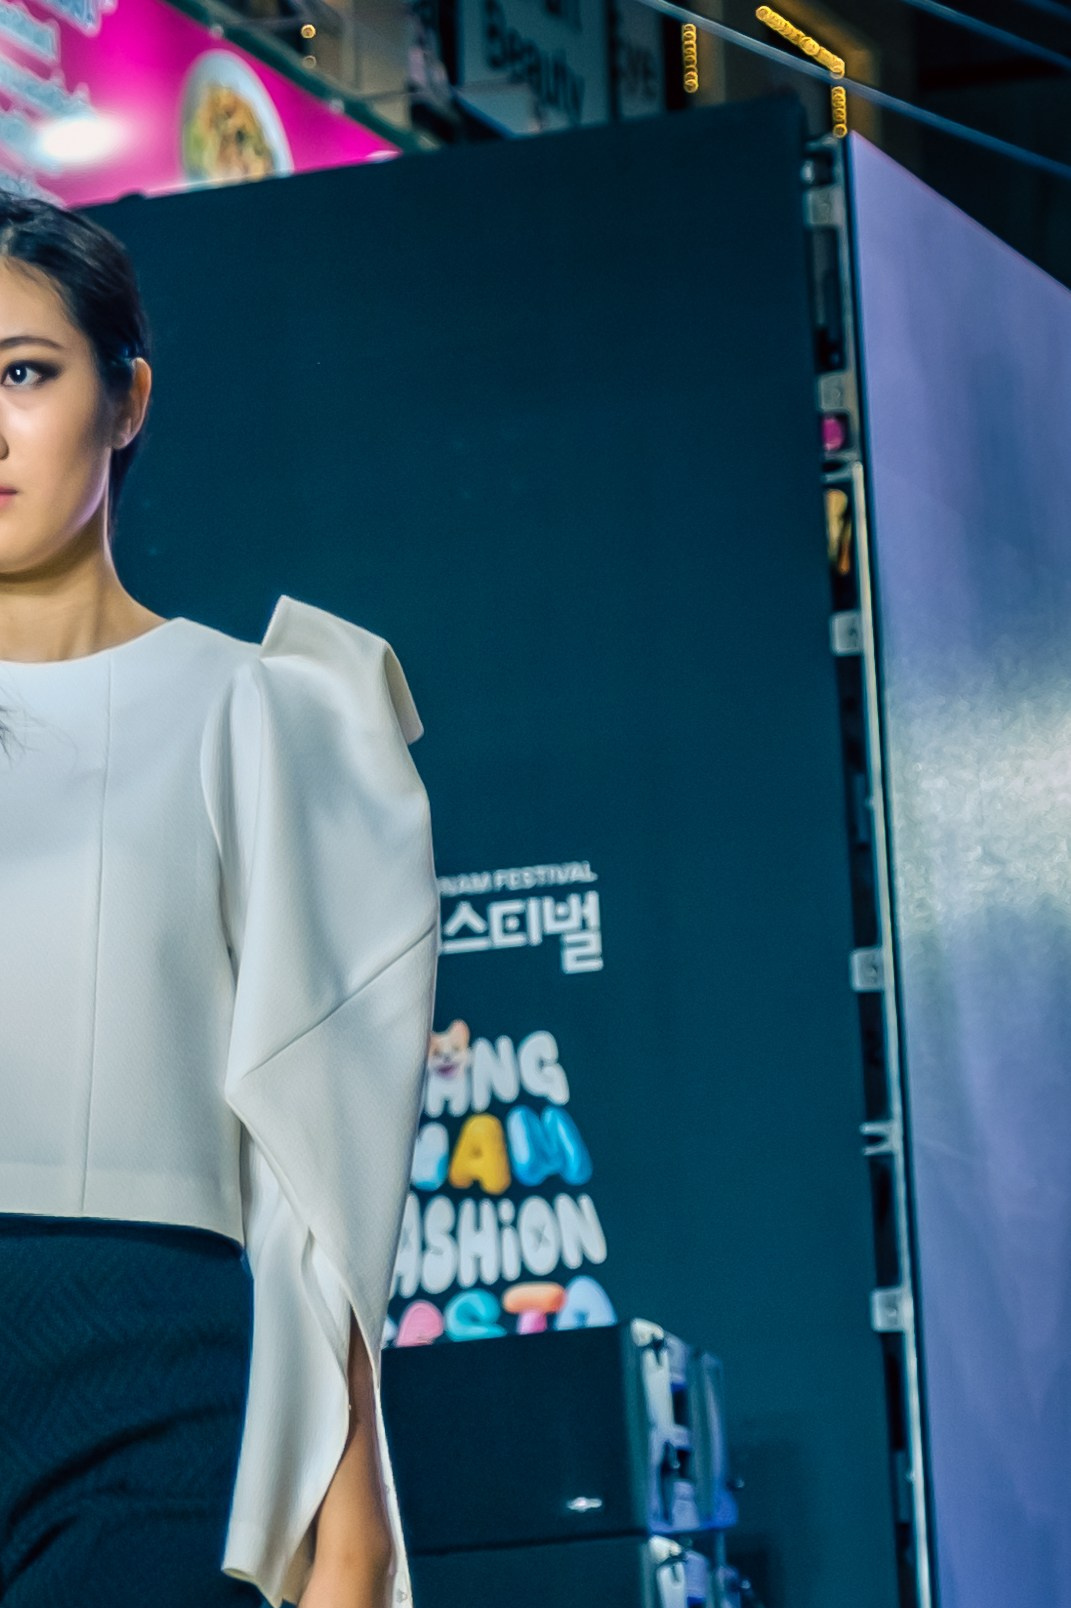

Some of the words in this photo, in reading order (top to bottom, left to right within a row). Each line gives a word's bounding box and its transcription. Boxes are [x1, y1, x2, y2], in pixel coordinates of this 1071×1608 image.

[437, 871, 492, 897] NAM
[492, 860, 598, 892] FESTIVAL
[438, 890, 604, 974] 스티벌
